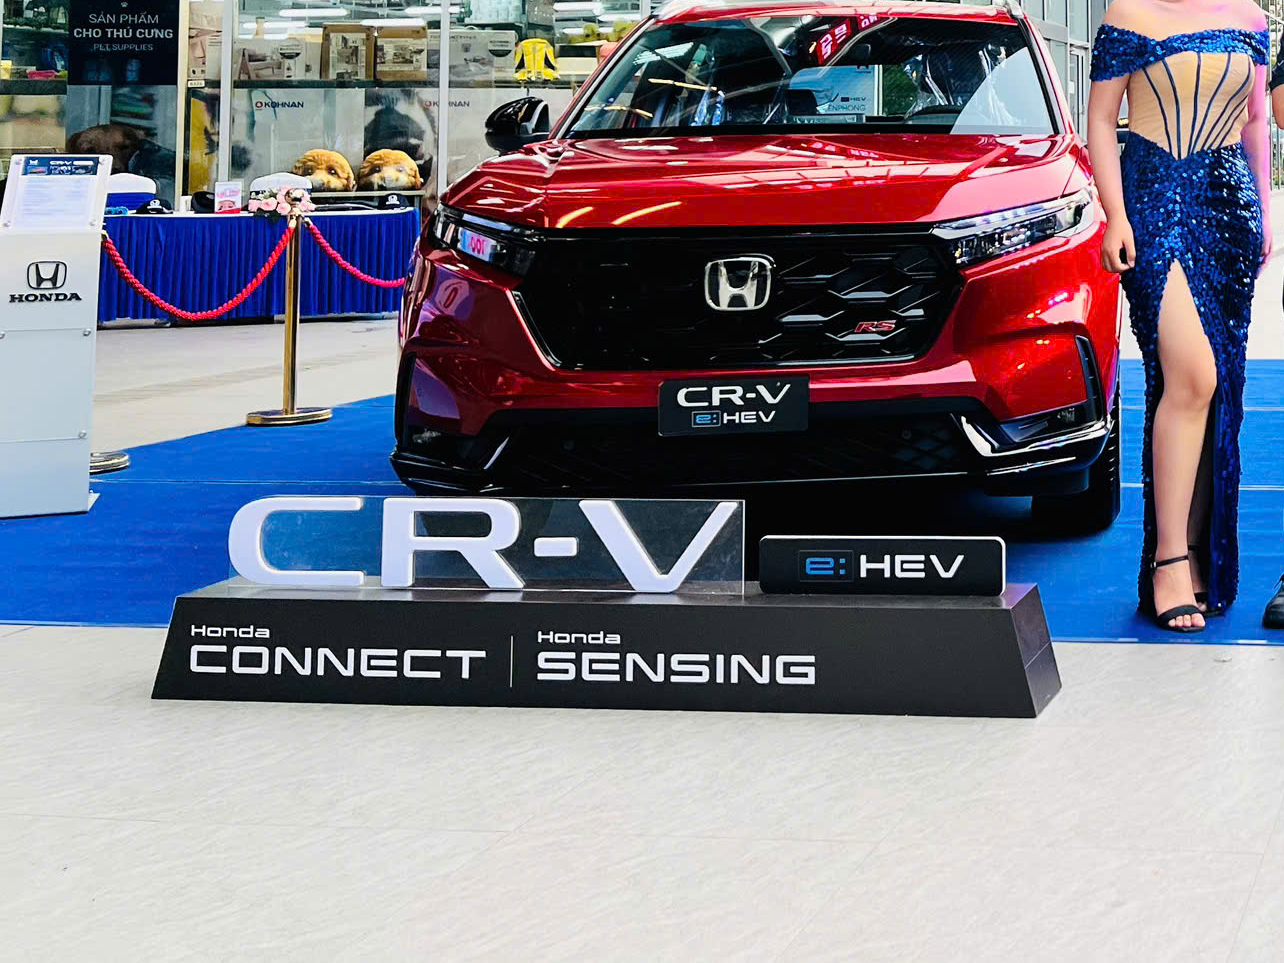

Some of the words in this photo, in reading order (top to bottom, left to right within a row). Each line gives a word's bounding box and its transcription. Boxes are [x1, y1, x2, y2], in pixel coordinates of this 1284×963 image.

[73, 28, 102, 38] CHO
[105, 26, 133, 38] THÚ
[136, 28, 174, 39] CƯNG
[93, 43, 110, 51] PET
[112, 43, 154, 51] SUPPLIES
[264, 101, 304, 109] KOHNAN
[9, 293, 82, 303] HONDA
[855, 320, 896, 333] RS
[677, 384, 791, 407] CR-V
[228, 496, 739, 594] CR-V
[191, 625, 270, 638] Honda
[537, 630, 621, 645] Honda
[190, 646, 487, 679] CONNECT
[536, 652, 816, 685] SENSING
